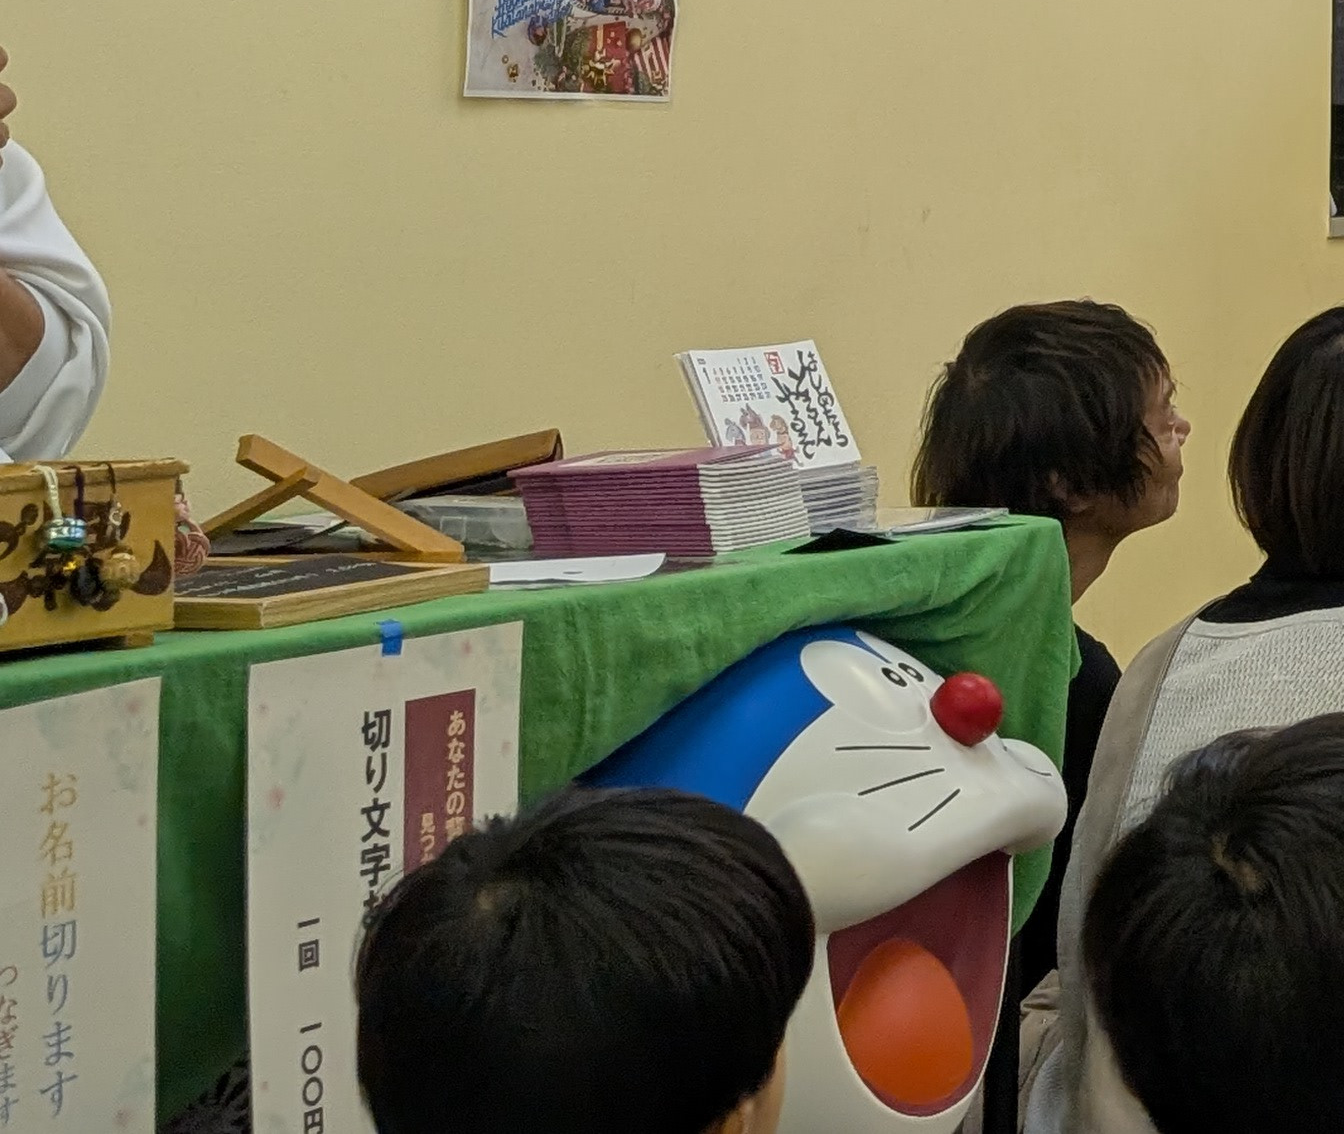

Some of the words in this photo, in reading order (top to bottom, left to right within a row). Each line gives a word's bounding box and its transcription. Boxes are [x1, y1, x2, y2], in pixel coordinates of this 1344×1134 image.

[39, 772, 78, 1117] お名前切ります
